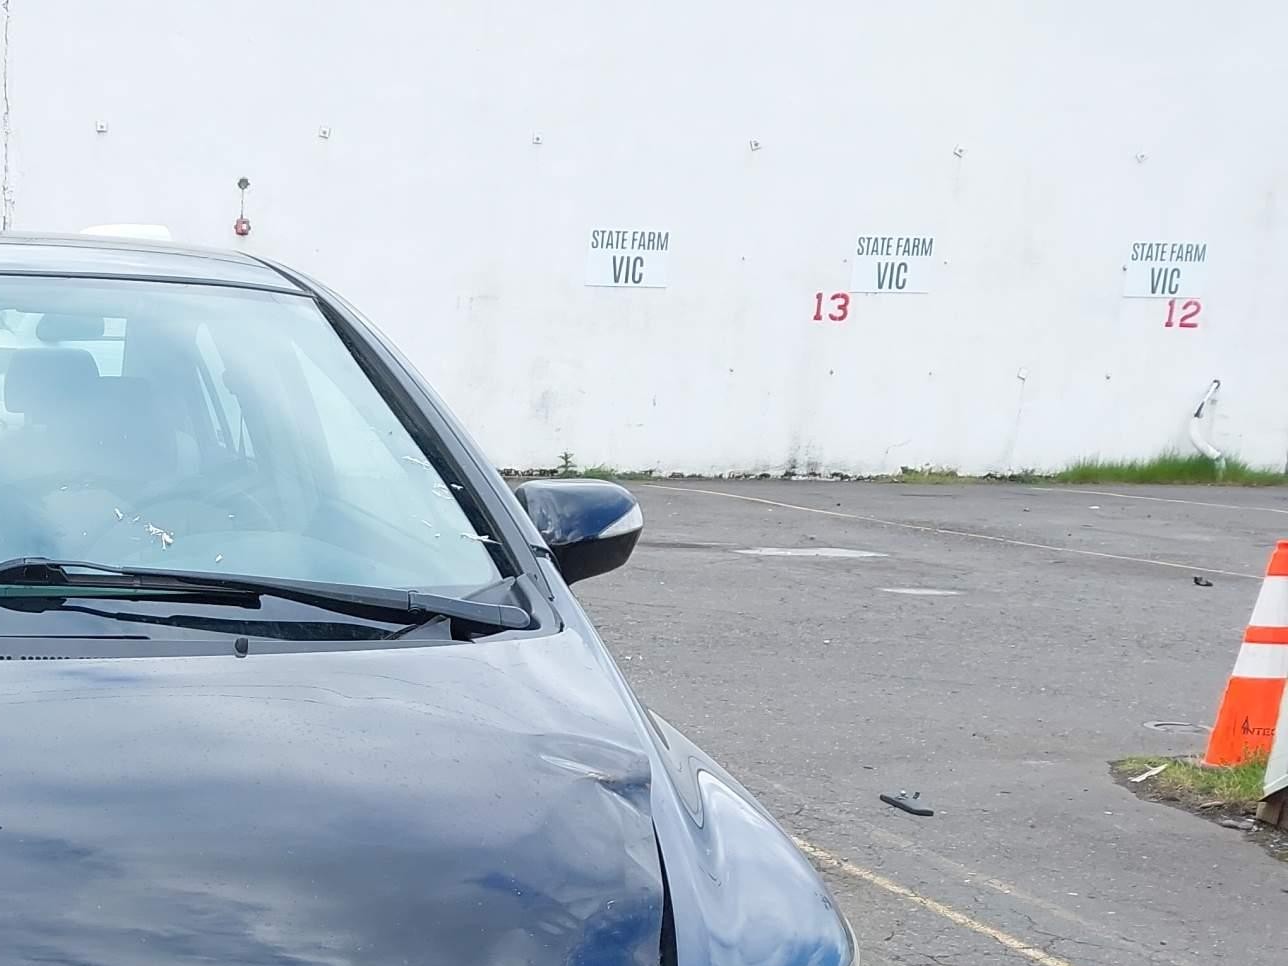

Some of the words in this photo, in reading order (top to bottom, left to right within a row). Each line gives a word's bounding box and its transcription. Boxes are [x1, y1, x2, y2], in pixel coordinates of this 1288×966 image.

[591, 230, 628, 249] STATE
[631, 231, 669, 250] FARM
[857, 236, 893, 256] STATE
[896, 237, 934, 256] FARM
[1131, 242, 1168, 261] STATE
[1170, 243, 1206, 262] FARM
[612, 255, 644, 284] VIC
[877, 262, 908, 290] VIC
[1150, 267, 1181, 294] VIC
[813, 292, 850, 321] 13
[1165, 298, 1201, 328] 12
